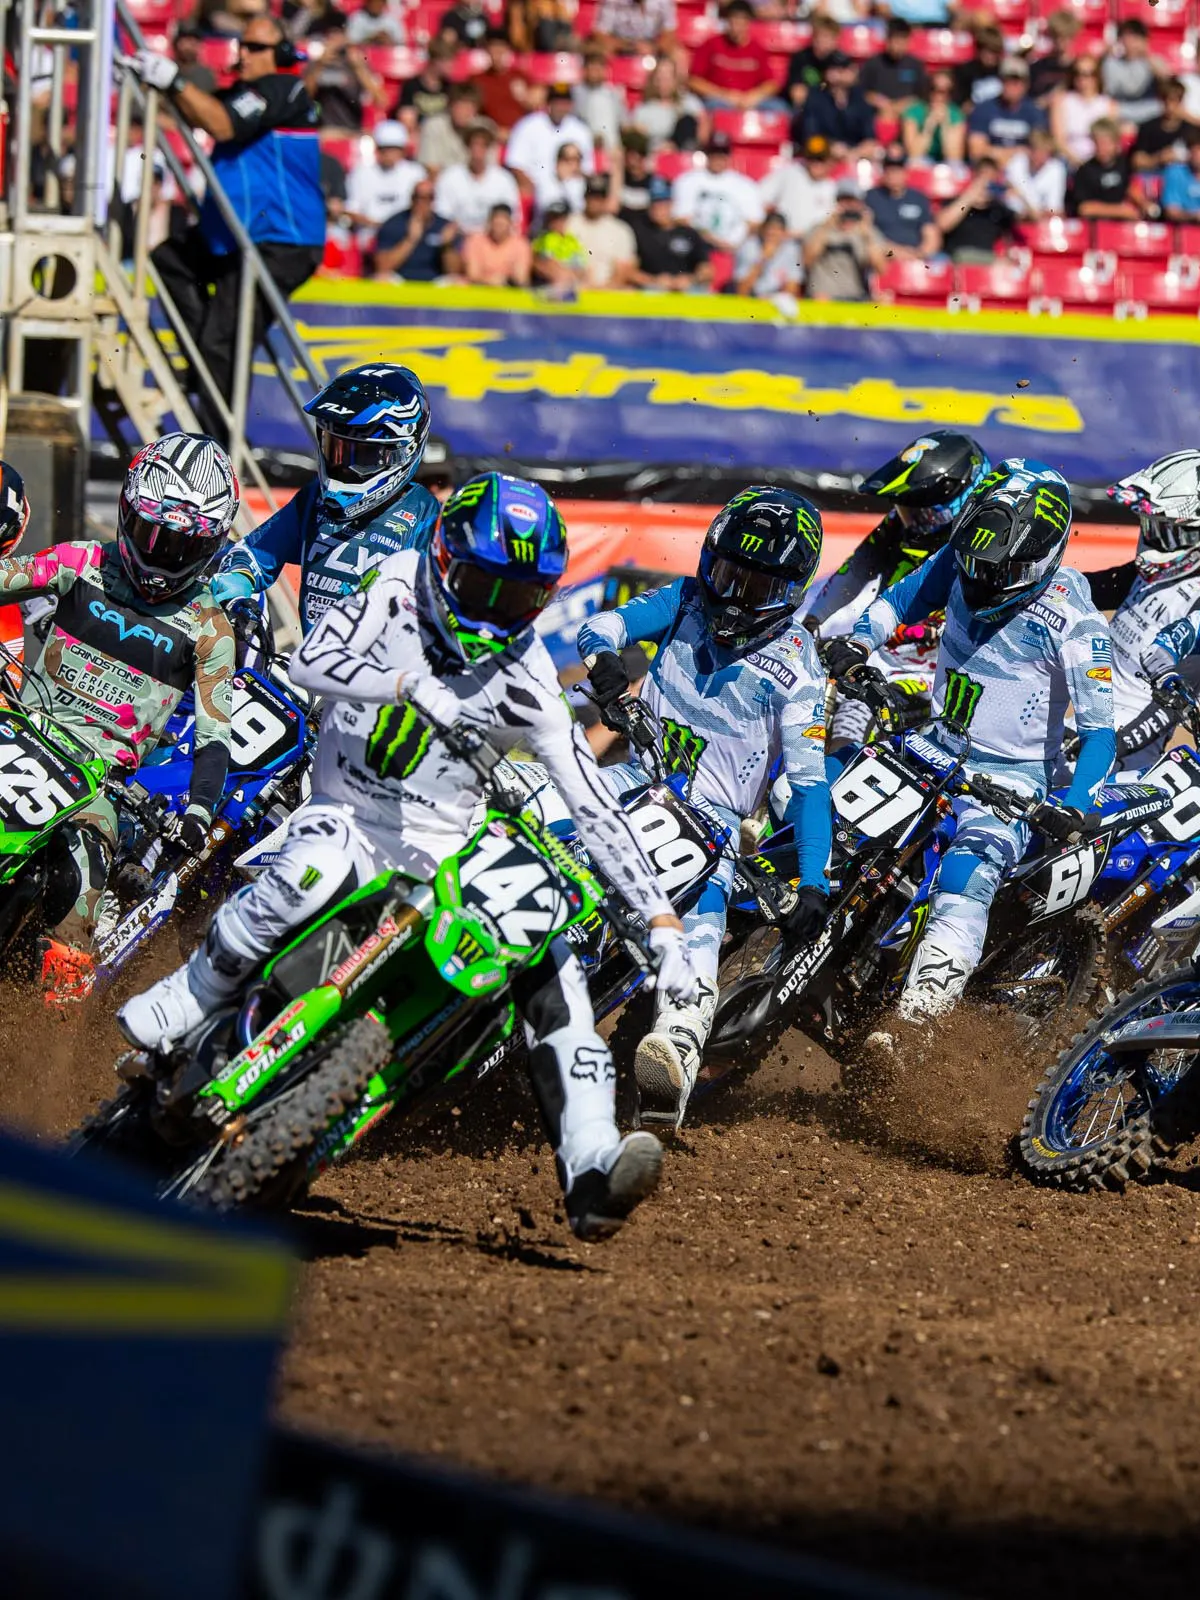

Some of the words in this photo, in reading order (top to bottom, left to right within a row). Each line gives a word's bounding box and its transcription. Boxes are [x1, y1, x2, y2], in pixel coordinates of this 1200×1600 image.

[317, 402, 355, 415] FLY
[167, 514, 187, 524] BELL
[1027, 602, 1062, 631] AMAHA
[56, 664, 78, 683] FG
[81, 672, 136, 704] FRIESEN
[70, 645, 145, 686] GRINDSTONE
[758, 656, 794, 686] YAMAHA
[75, 698, 120, 722] TWISTED
[77, 681, 122, 706] GROUP
[1123, 709, 1171, 749] SEVEN
[22, 731, 66, 772] SUPERCROSS
[904, 734, 952, 771] PROTAPER
[0, 743, 75, 826] 125
[831, 757, 924, 839] 61
[673, 801, 705, 839] SUPERCROSS
[1125, 801, 1163, 821] DUNLOP
[458, 834, 568, 947] 142
[1045, 843, 1095, 916] 61
[103, 895, 161, 959] DUNLOP
[236, 1021, 307, 1095] DUNLOP
